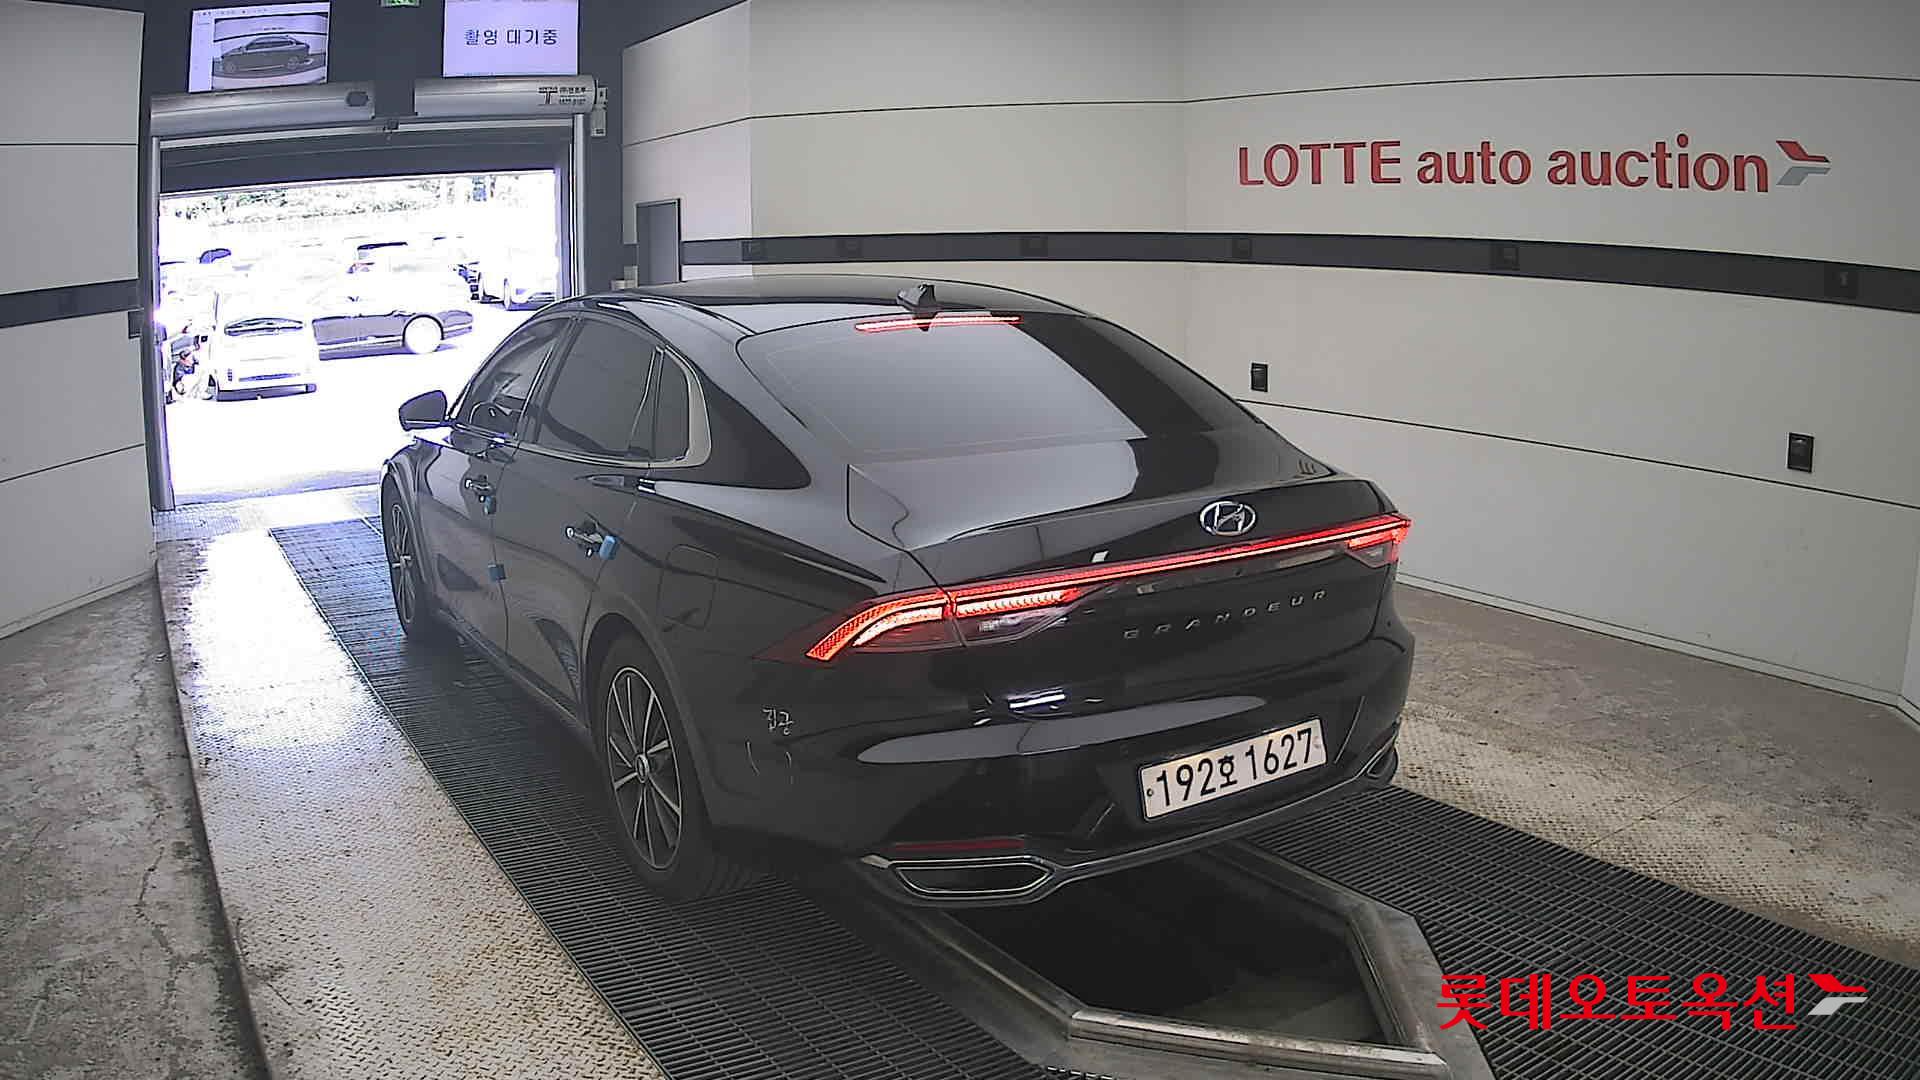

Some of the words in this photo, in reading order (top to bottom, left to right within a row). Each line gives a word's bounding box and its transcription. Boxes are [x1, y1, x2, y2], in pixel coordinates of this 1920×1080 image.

[506, 29, 558, 46] 대기중
[1239, 139, 1400, 187] LOTTE
[1416, 141, 1532, 185] auto
[1547, 133, 1769, 193] auction
[1123, 590, 1327, 639] GRANDEUR
